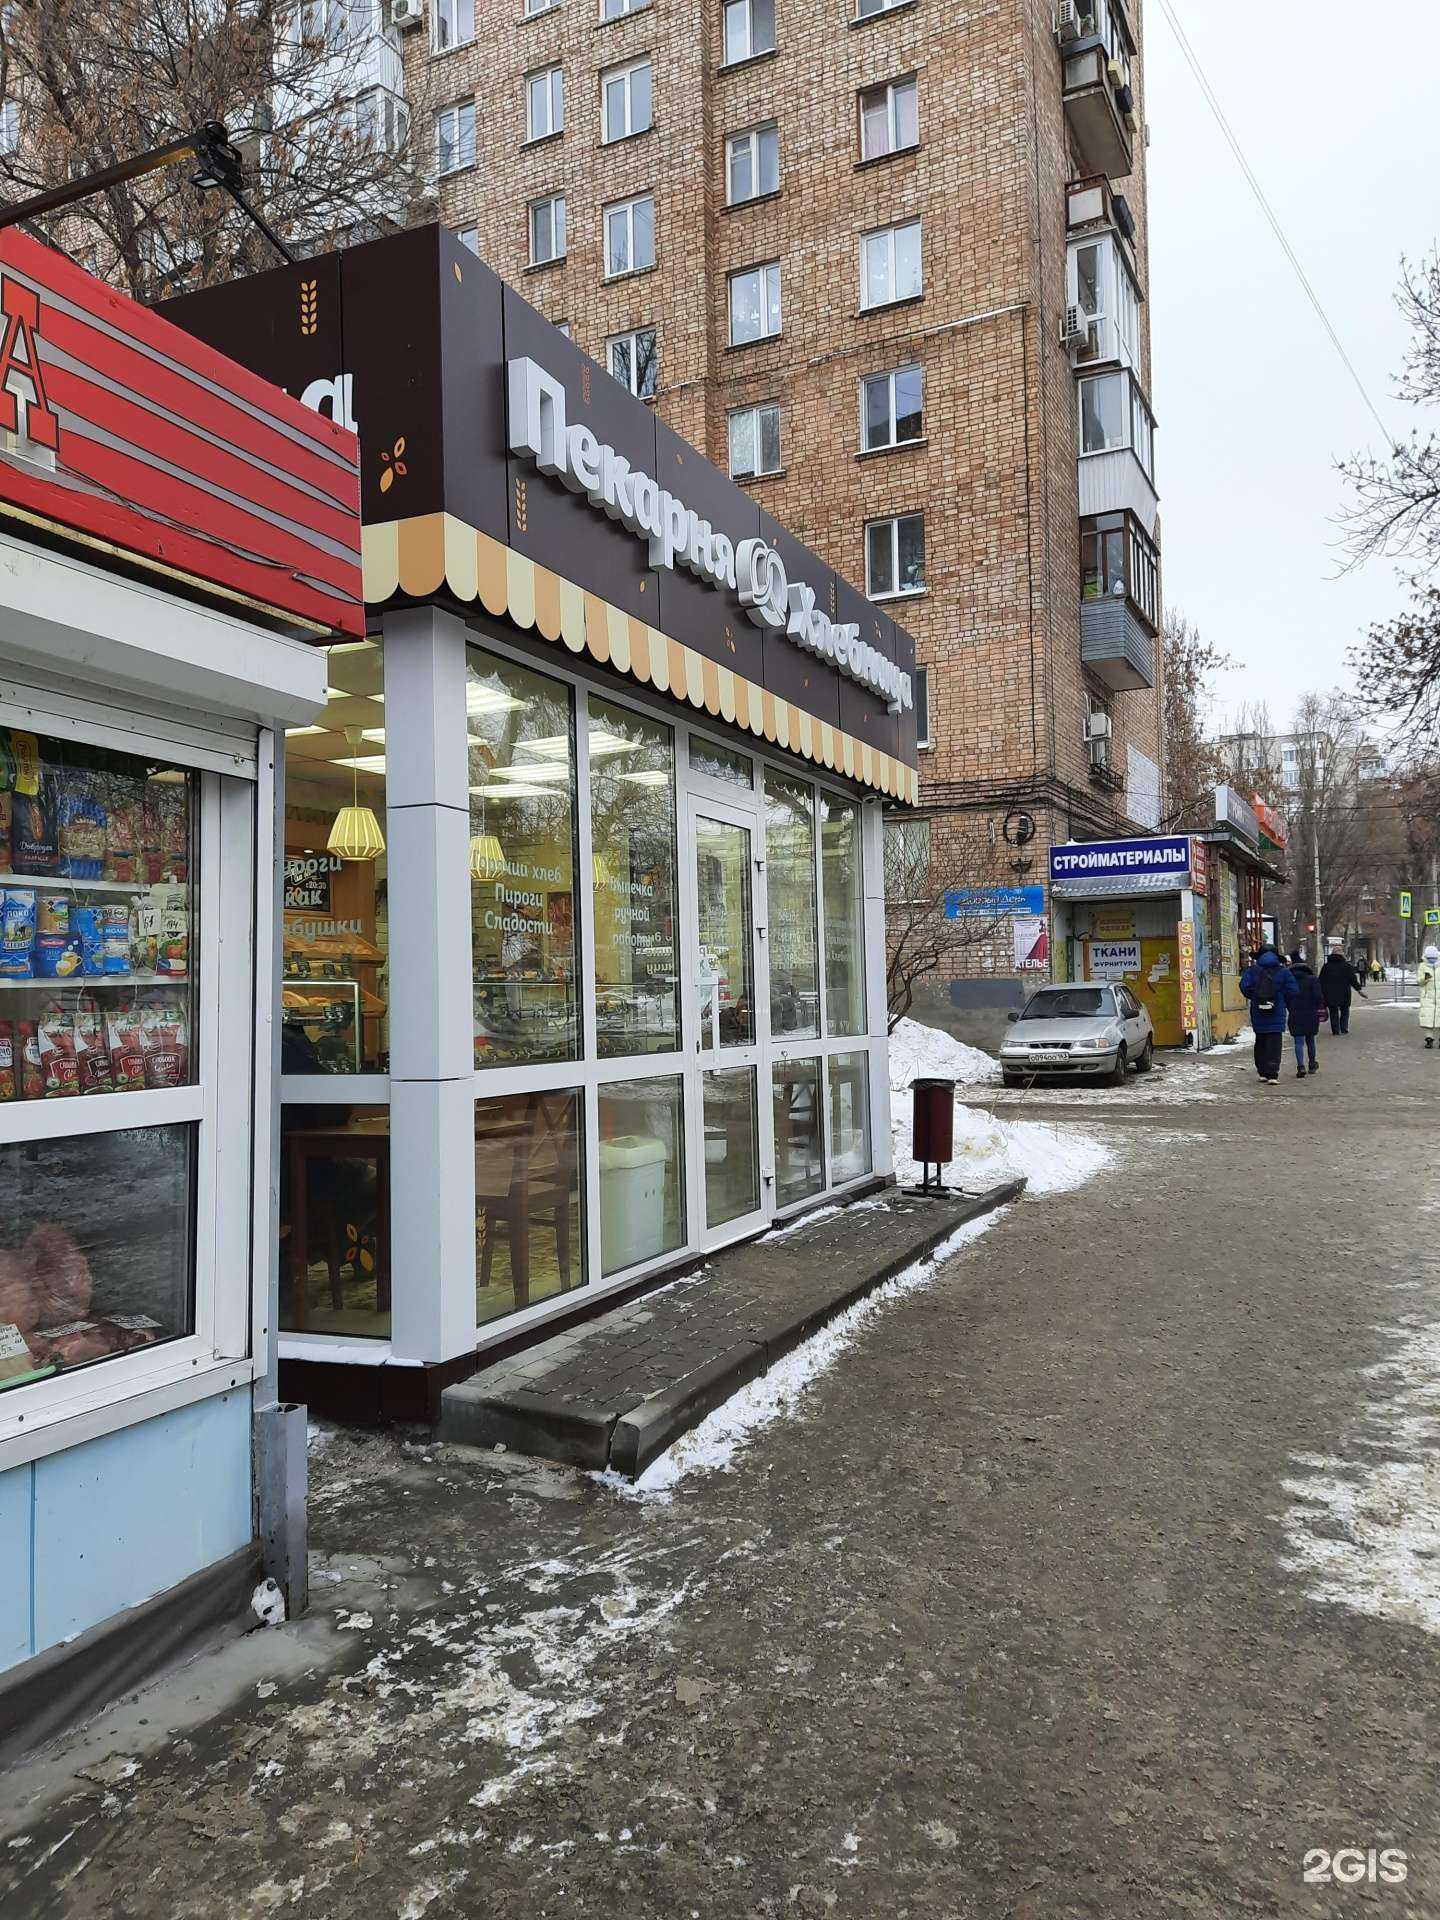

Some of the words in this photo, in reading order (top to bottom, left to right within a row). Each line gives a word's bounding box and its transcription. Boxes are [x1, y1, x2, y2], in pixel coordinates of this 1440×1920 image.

[508, 357, 738, 592] Пекарня
[1053, 847, 1186, 871] СТРОЙМАТЕРИАЛЫ
[495, 882, 544, 909] Пироги
[609, 875, 654, 897] Выпечка
[484, 910, 554, 935] Сладости
[614, 905, 651, 926] ручной
[1092, 946, 1137, 958] ТКАНИ
[1014, 959, 1050, 969] АТЕЛЬЕ
[1094, 960, 1138, 968] ФУРНИТУРА
